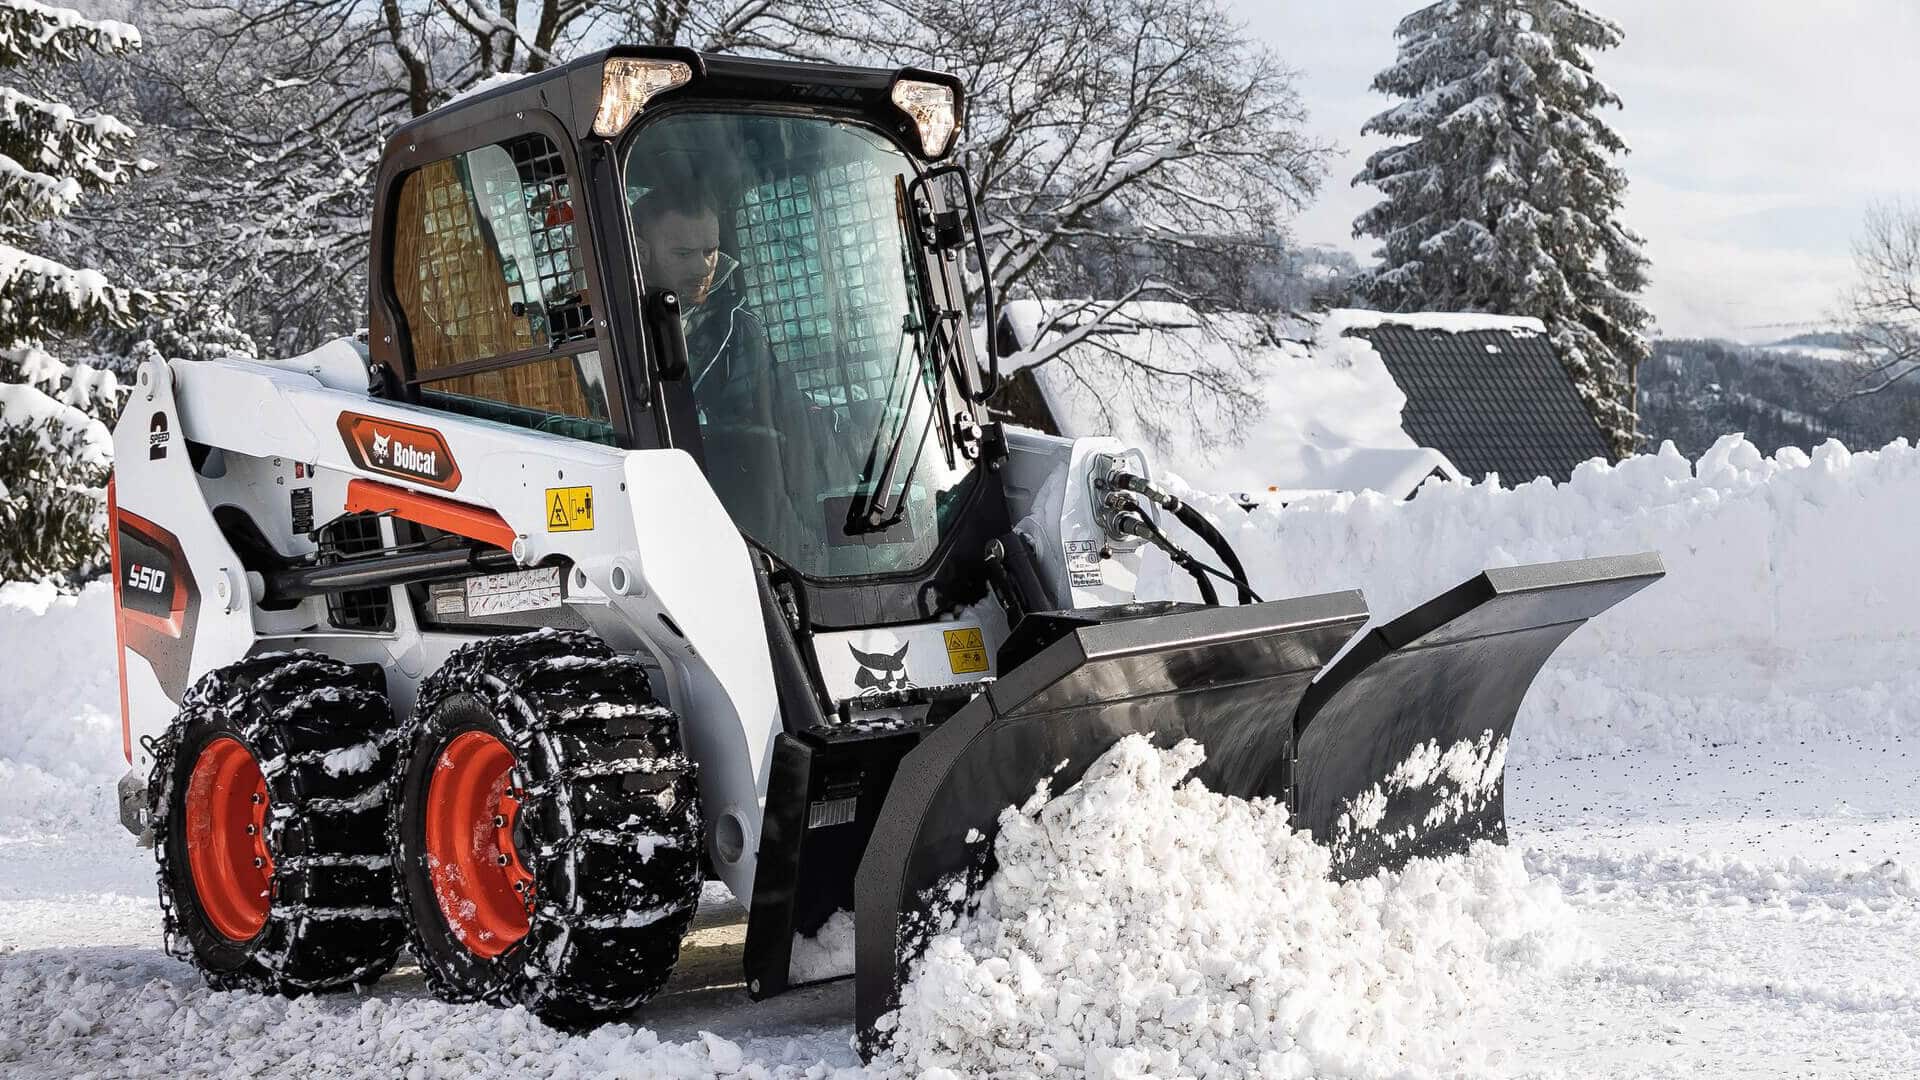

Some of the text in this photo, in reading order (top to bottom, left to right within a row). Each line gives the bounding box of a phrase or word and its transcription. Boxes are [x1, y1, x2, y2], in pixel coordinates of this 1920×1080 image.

[150, 432, 170, 445] SPEED
[393, 441, 436, 476] Bobcat
[128, 563, 166, 593] S510
